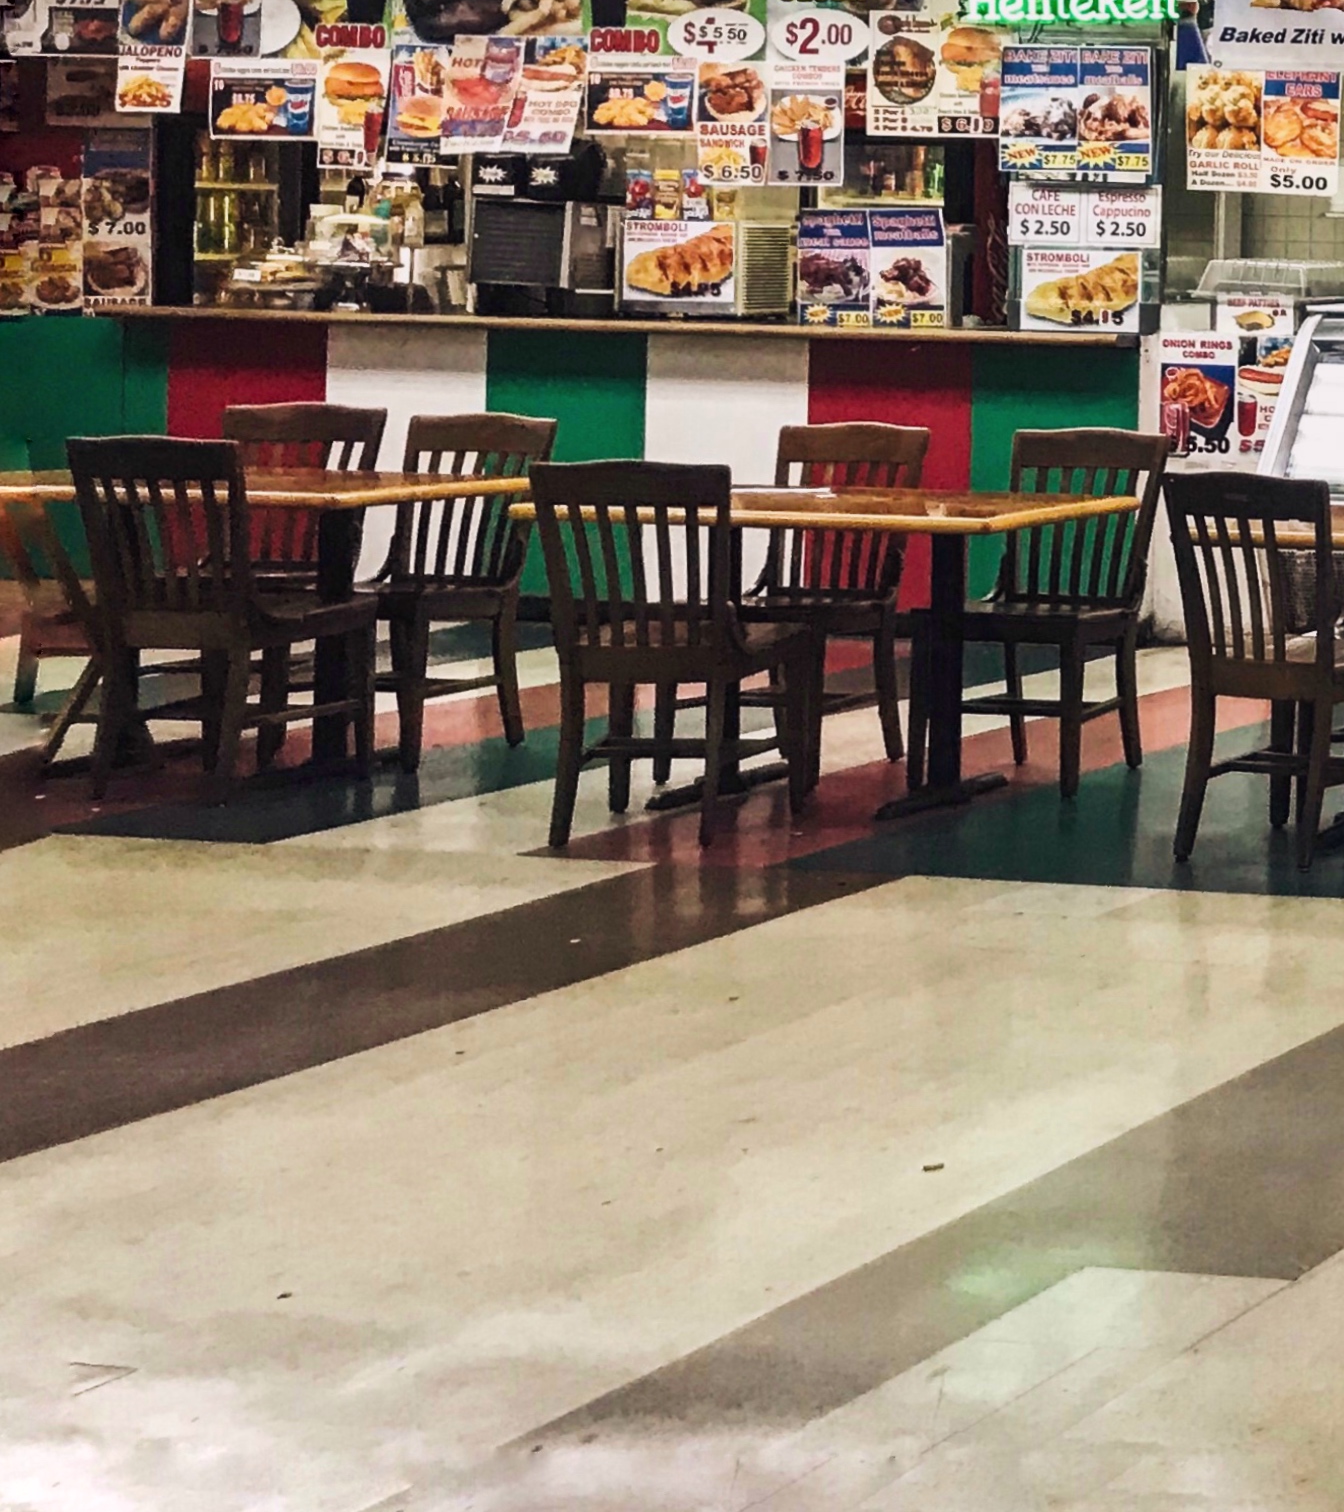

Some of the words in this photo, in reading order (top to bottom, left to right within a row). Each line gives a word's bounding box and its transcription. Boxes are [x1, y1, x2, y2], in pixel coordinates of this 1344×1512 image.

[316, 24, 386, 49] COMBO
[590, 29, 660, 53] COMBO
[786, 18, 851, 55] $2.00
[1219, 27, 1287, 44] Baked
[1290, 29, 1324, 45] Ziti
[120, 46, 182, 57] JALOPENO
[1005, 49, 1047, 63] BAKE
[1050, 49, 1078, 63] ZITI
[1082, 50, 1119, 63] BAKE
[1123, 50, 1148, 64] ZITI
[1285, 84, 1322, 97] EARS
[700, 124, 766, 136] SAUSAGE
[700, 139, 745, 148] SANDWICH
[1007, 148, 1036, 160] NEW
[1080, 146, 1112, 159] NEW
[1043, 153, 1076, 166] $7.75
[1118, 155, 1149, 167] $7.75
[1189, 160, 1230, 169] GARLIC
[1233, 162, 1259, 171] ROLL
[722, 165, 762, 180] 6.50
[1270, 174, 1328, 190] $5.00
[1032, 190, 1060, 202] CAFE
[1099, 192, 1146, 203] Espresso
[1015, 203, 1039, 215] CON
[1042, 204, 1076, 216] LECHE
[1093, 205, 1151, 219] Cappucino
[105, 222, 146, 235] 7.00
[626, 222, 689, 232] STROMBOLI
[1034, 220, 1070, 235] 2.50
[1110, 222, 1146, 237] 2.50
[1026, 253, 1090, 263] STROMBOLI
[1163, 340, 1195, 348] ONION
[1200, 341, 1233, 350] RINGS
[1182, 350, 1216, 359] COMBO
